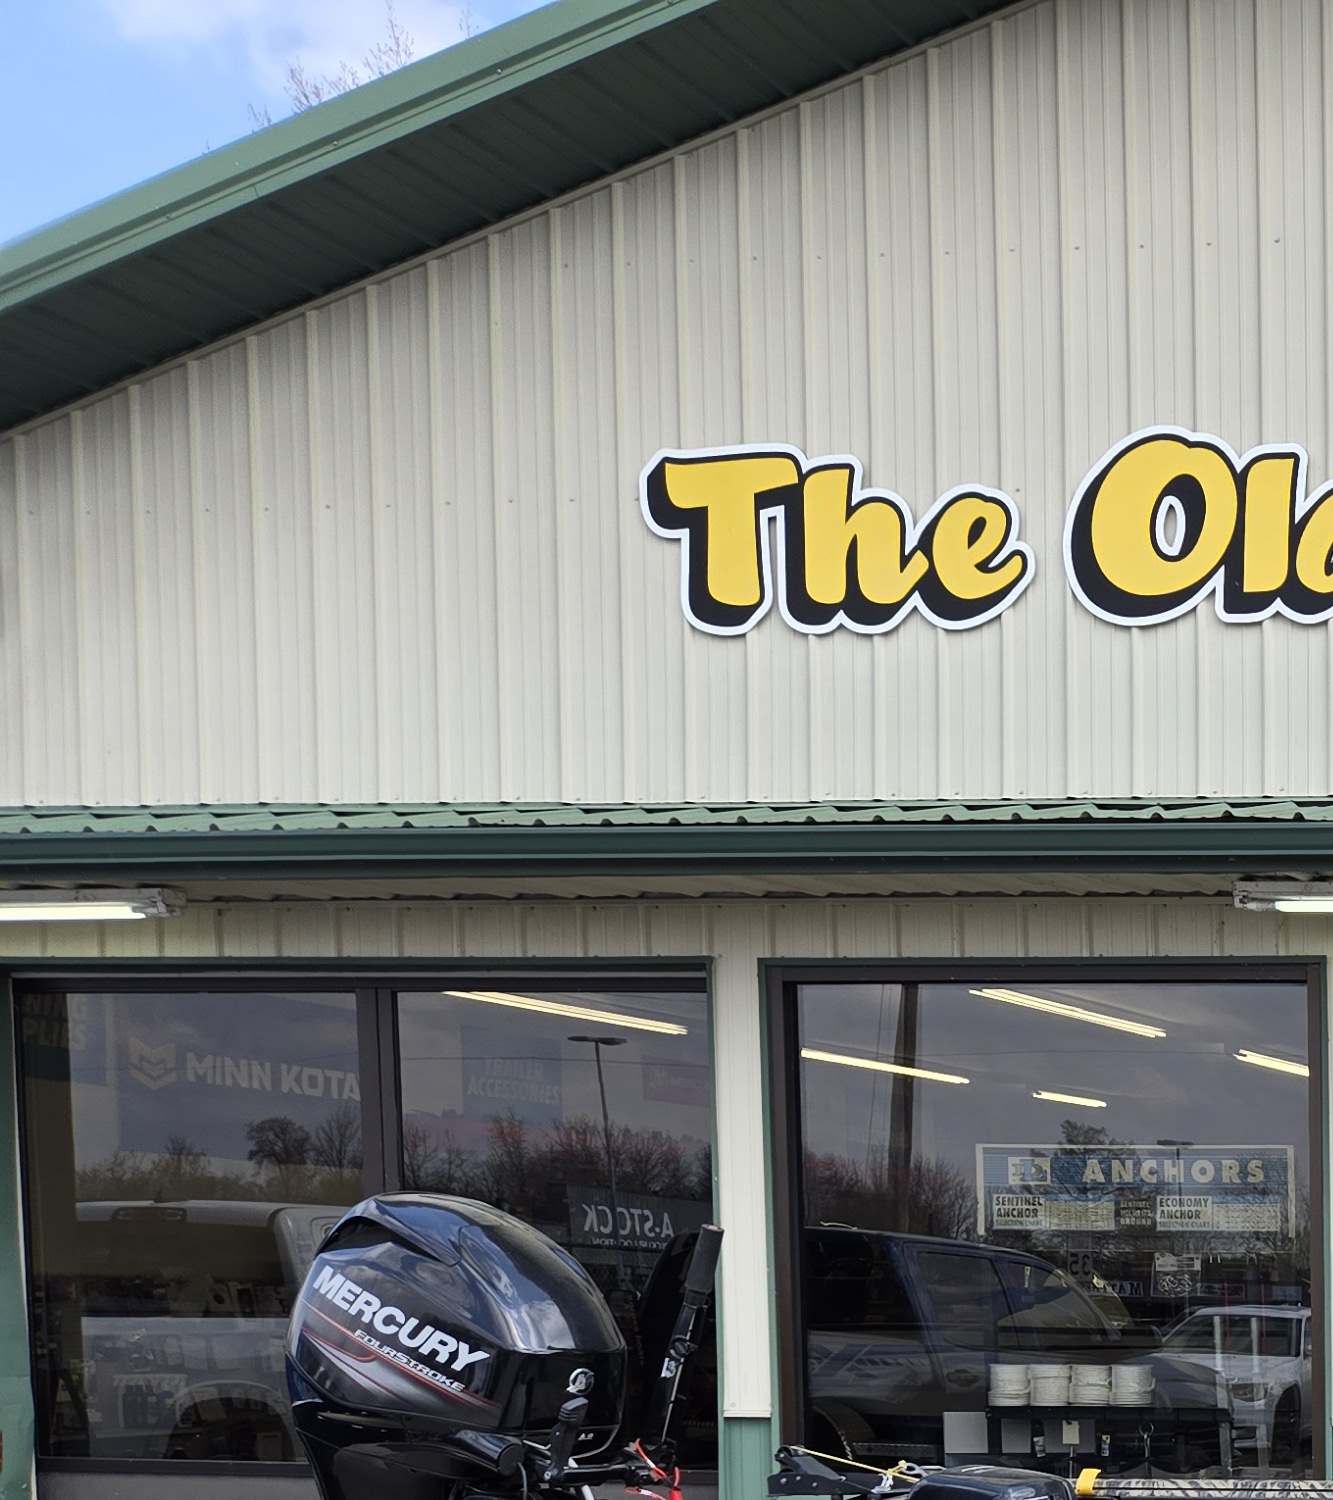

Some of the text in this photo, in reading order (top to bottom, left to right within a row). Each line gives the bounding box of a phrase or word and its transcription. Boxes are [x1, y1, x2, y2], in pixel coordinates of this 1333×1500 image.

[645, 450, 1028, 630] The
[185, 1051, 361, 1101] MINN KOTA
[466, 1075, 560, 1105] ACCESSORIES
[1081, 1159, 1265, 1184] ANCHORS
[995, 1195, 1043, 1207] SENTINEL
[996, 1207, 1039, 1219] ANCHOR
[1159, 1197, 1210, 1208] ECONOMY
[1160, 1209, 1202, 1220] ANCHOR
[313, 1266, 491, 1372] MERCURY
[353, 1328, 466, 1393] FOURSTROKE
